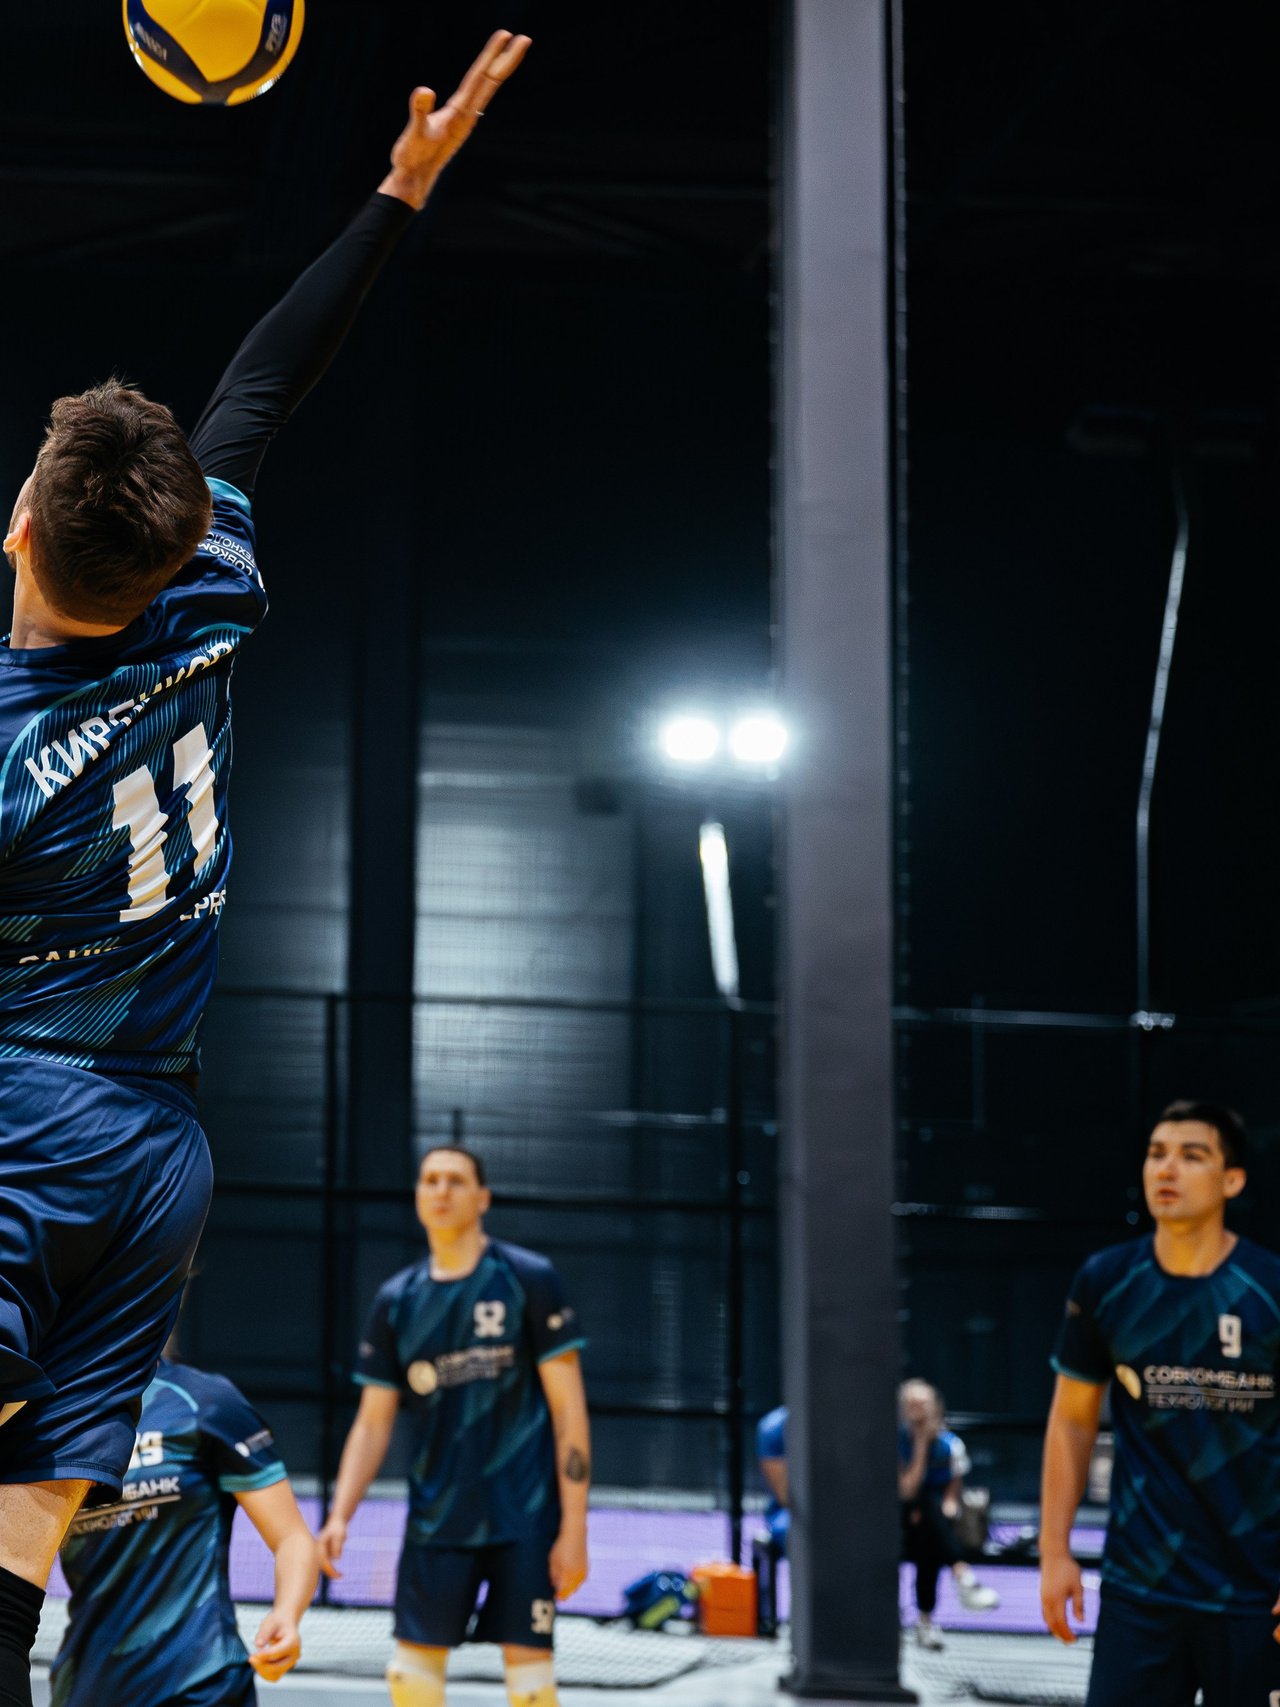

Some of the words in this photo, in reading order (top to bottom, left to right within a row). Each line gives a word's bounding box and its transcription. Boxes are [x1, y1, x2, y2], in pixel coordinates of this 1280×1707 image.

[198, 541, 253, 576] СОВКОМ
[113, 722, 219, 922] 11
[1218, 1313, 1242, 1358] 9
